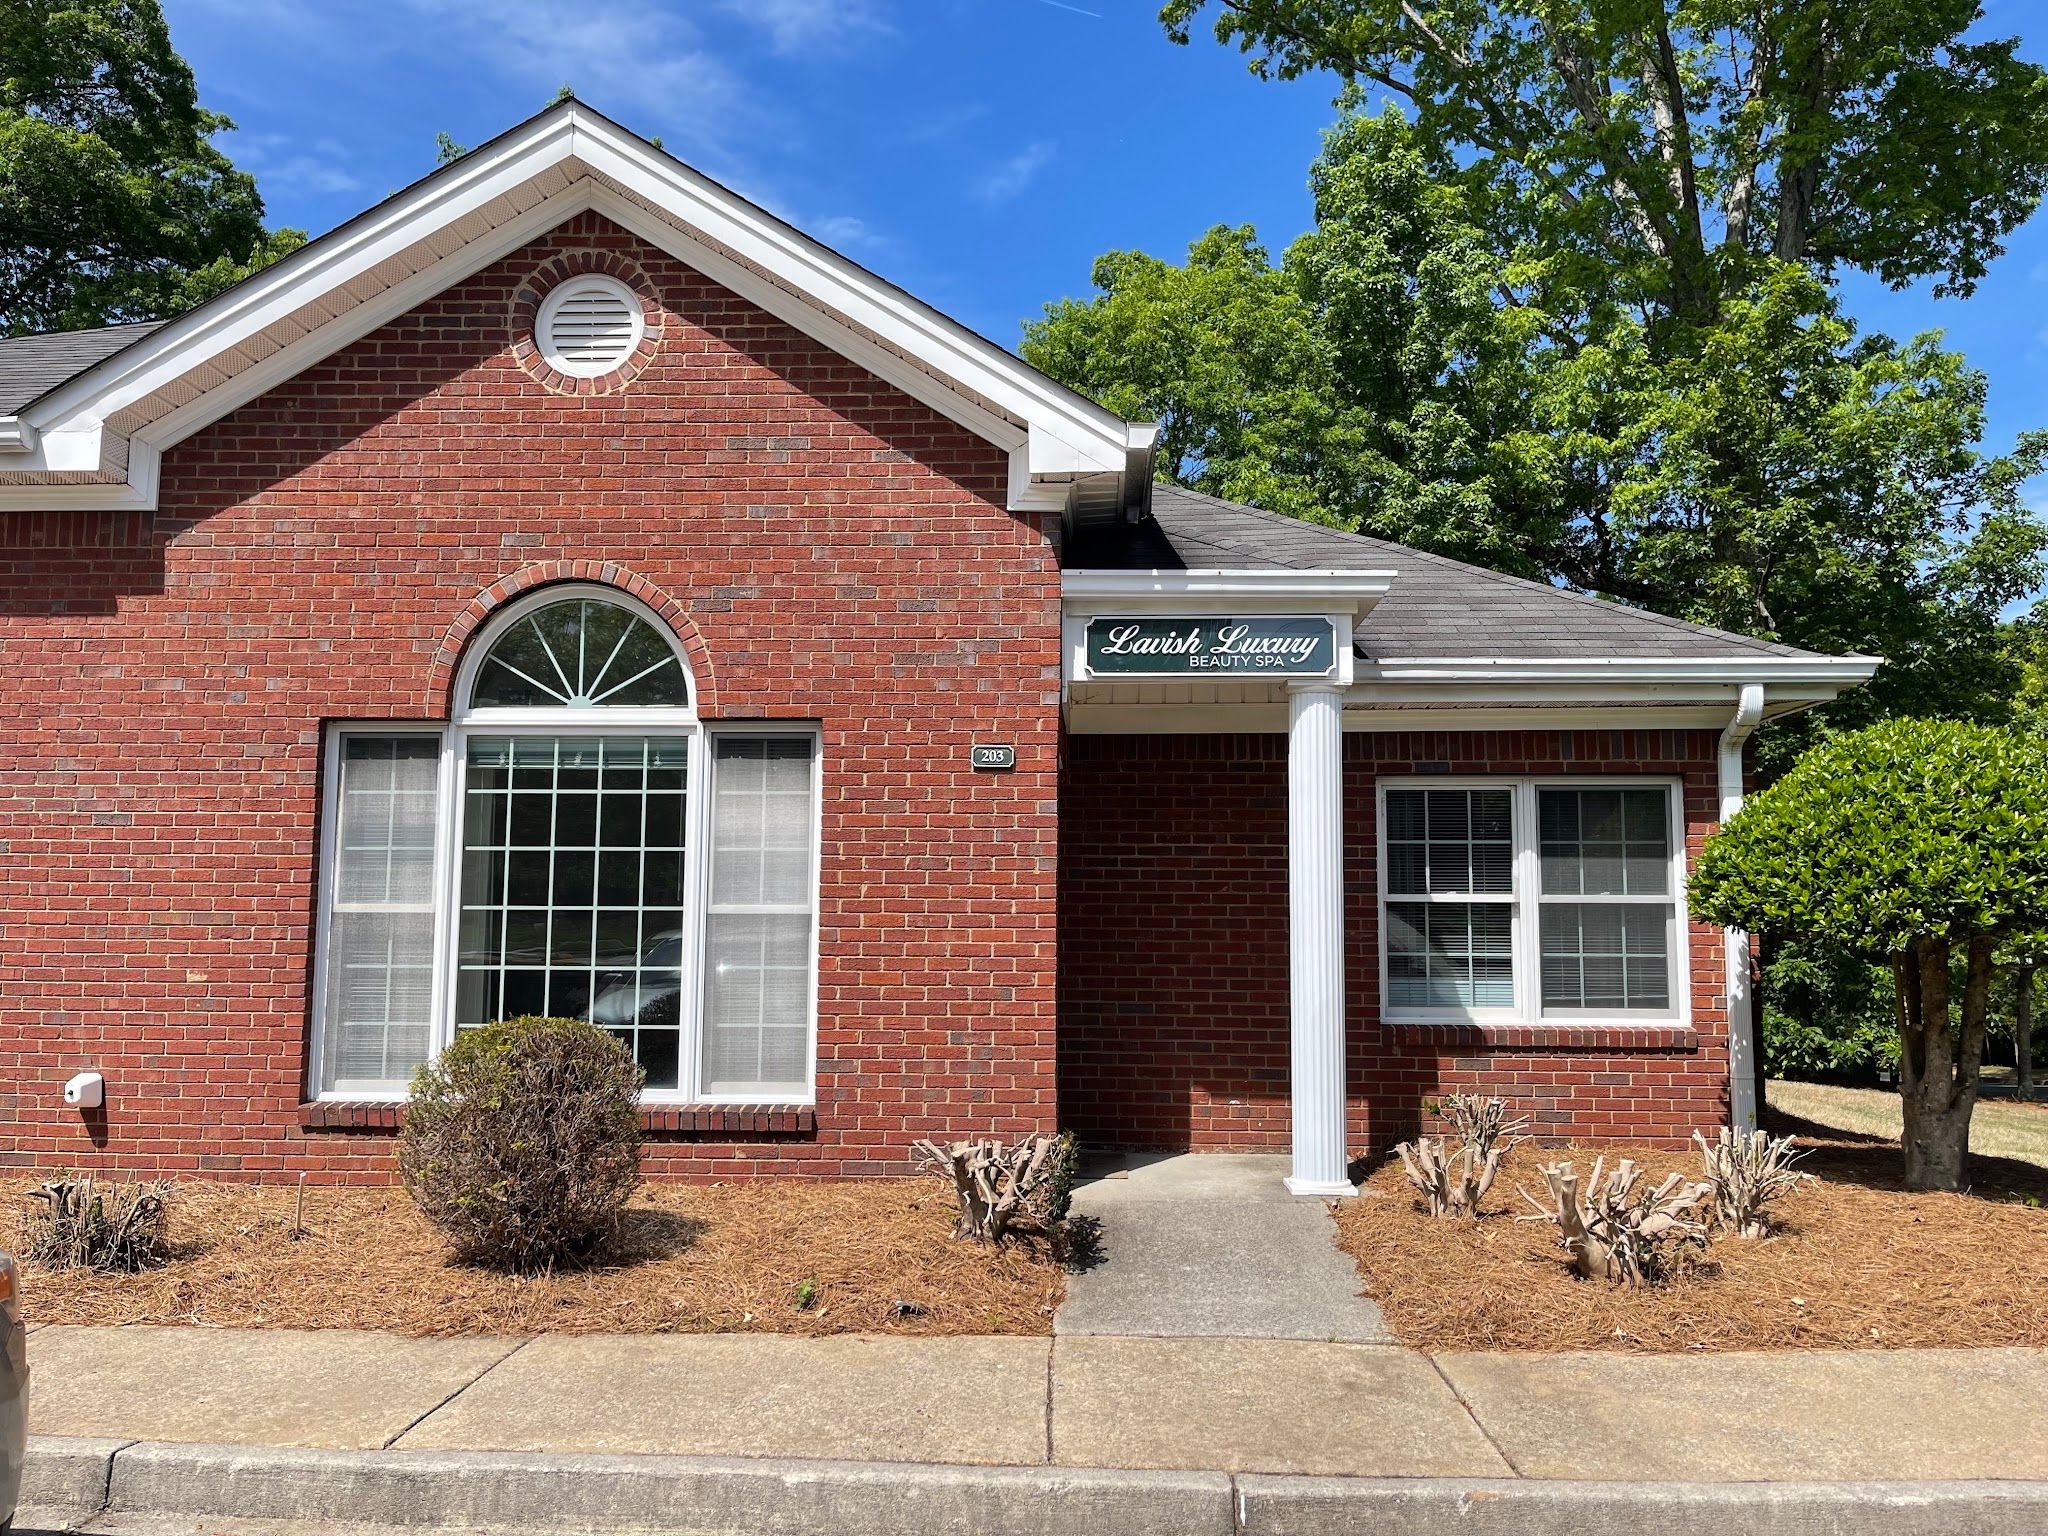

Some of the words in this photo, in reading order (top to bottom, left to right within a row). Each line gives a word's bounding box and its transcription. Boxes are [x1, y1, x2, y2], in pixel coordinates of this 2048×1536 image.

[1100, 624, 1203, 655] Lavish
[1210, 624, 1319, 663] Luxury
[1189, 655, 1249, 667] BEAUTY
[1255, 655, 1285, 667] SPA
[981, 750, 1004, 762] 203
